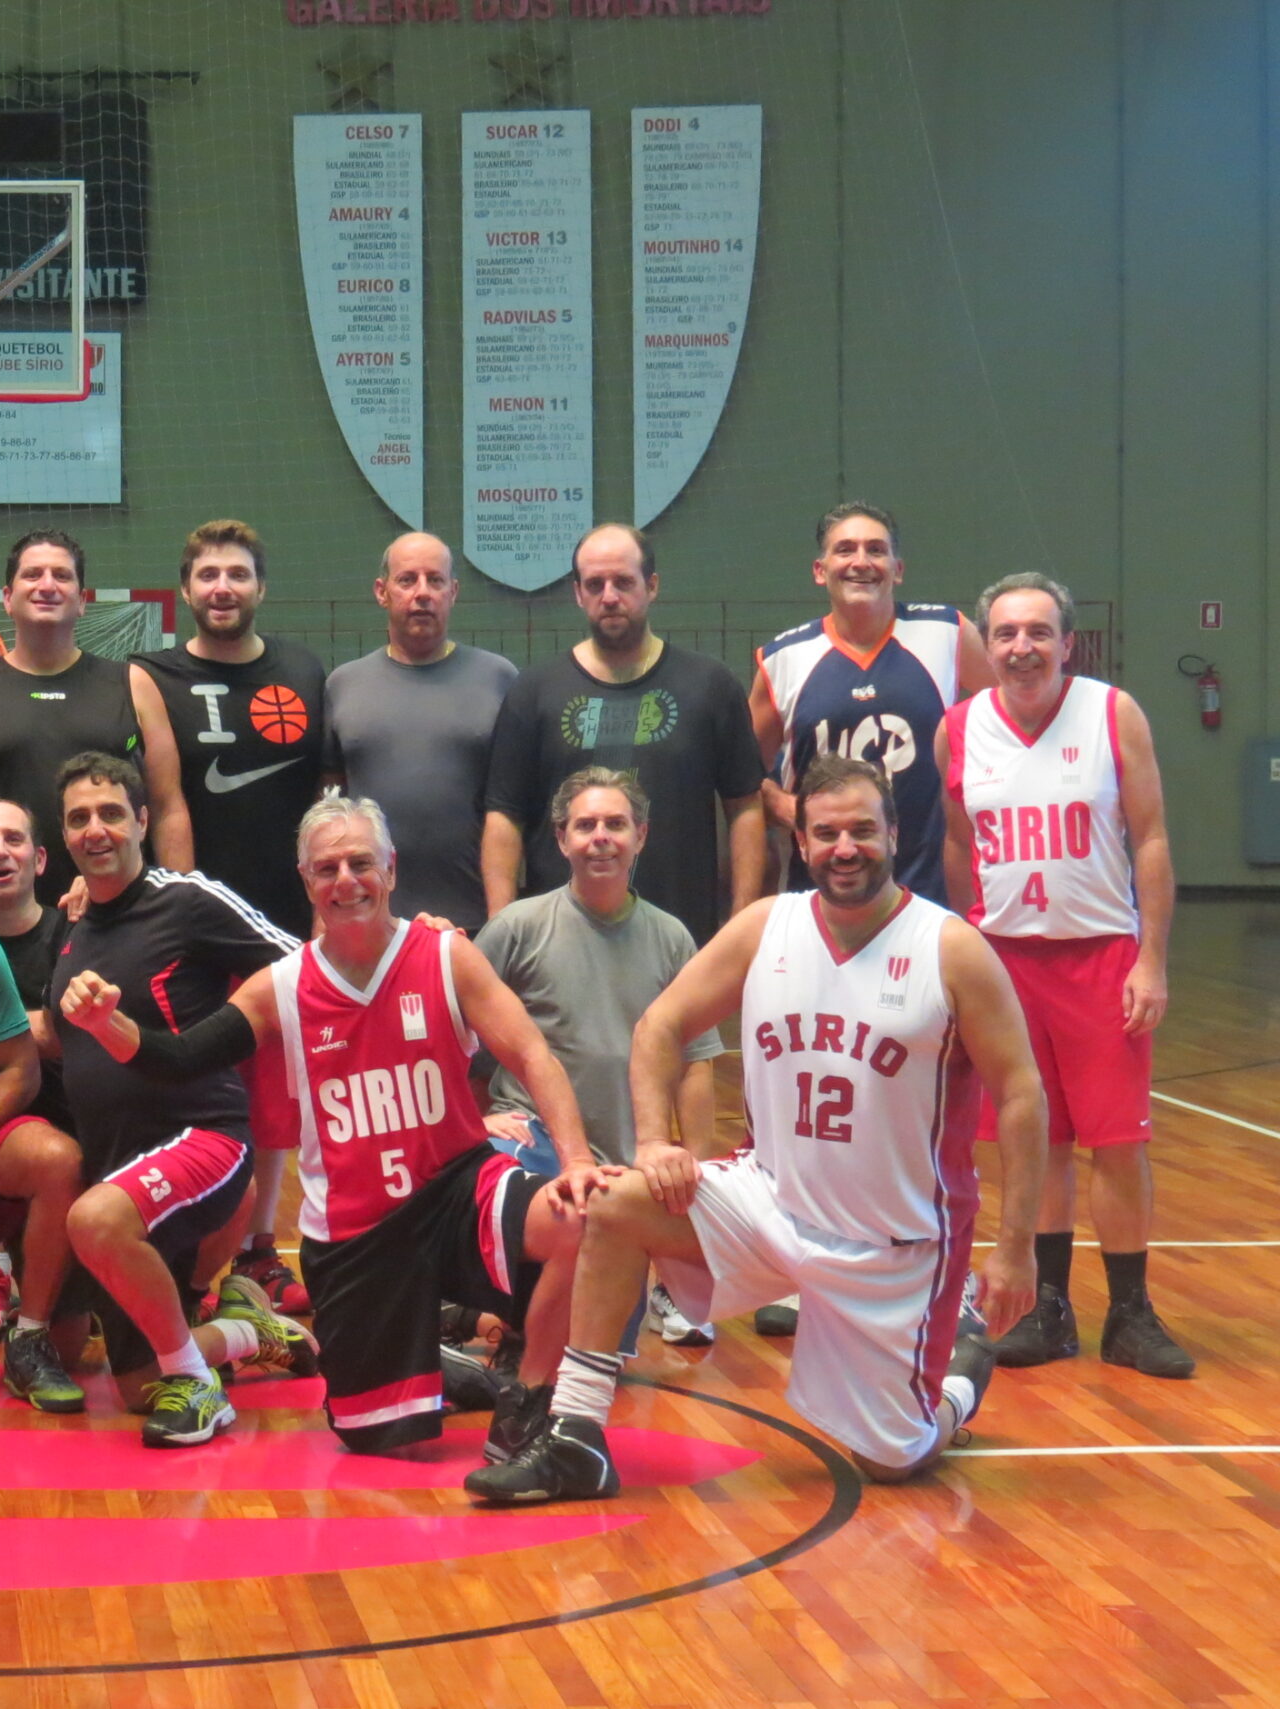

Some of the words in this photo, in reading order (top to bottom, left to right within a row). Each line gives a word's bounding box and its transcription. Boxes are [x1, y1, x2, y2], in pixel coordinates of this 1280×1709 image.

[345, 126, 393, 140] CELSO
[398, 125, 409, 138] 7
[486, 125, 538, 140] SUCAR
[543, 124, 565, 138] 12
[644, 118, 681, 133] DODI
[688, 117, 700, 131] 4
[328, 207, 393, 221] AMAURY
[398, 207, 410, 220] 4
[485, 231, 540, 247] VICTOR
[546, 231, 567, 245] 13
[643, 240, 720, 255] MOUTINHO
[724, 238, 744, 252] 14
[337, 279, 394, 293] EURICO
[399, 279, 411, 293] 8
[483, 309, 557, 325] RADVILAS
[561, 309, 573, 323] 5
[644, 332, 730, 349] MARQUINHOS
[727, 322, 737, 334] 9
[26, 356, 64, 371] SÍRIO
[336, 352, 394, 366] AYRTON
[399, 352, 411, 365] 5
[488, 397, 545, 412] MENON
[549, 397, 569, 411] 11
[376, 443, 411, 453] ANGEL
[370, 455, 411, 465] CRESPO
[477, 488, 558, 504] MOSQUITO
[562, 488, 584, 502] 15
[190, 684, 237, 744] I
[976, 801, 1091, 865] SIRIO
[1021, 871, 1049, 913] 4
[756, 1013, 908, 1077] SIRIO
[318, 1059, 446, 1143] SIRIO
[795, 1071, 854, 1143] 12
[380, 1148, 412, 1198] 5
[139, 1167, 172, 1203] 23
